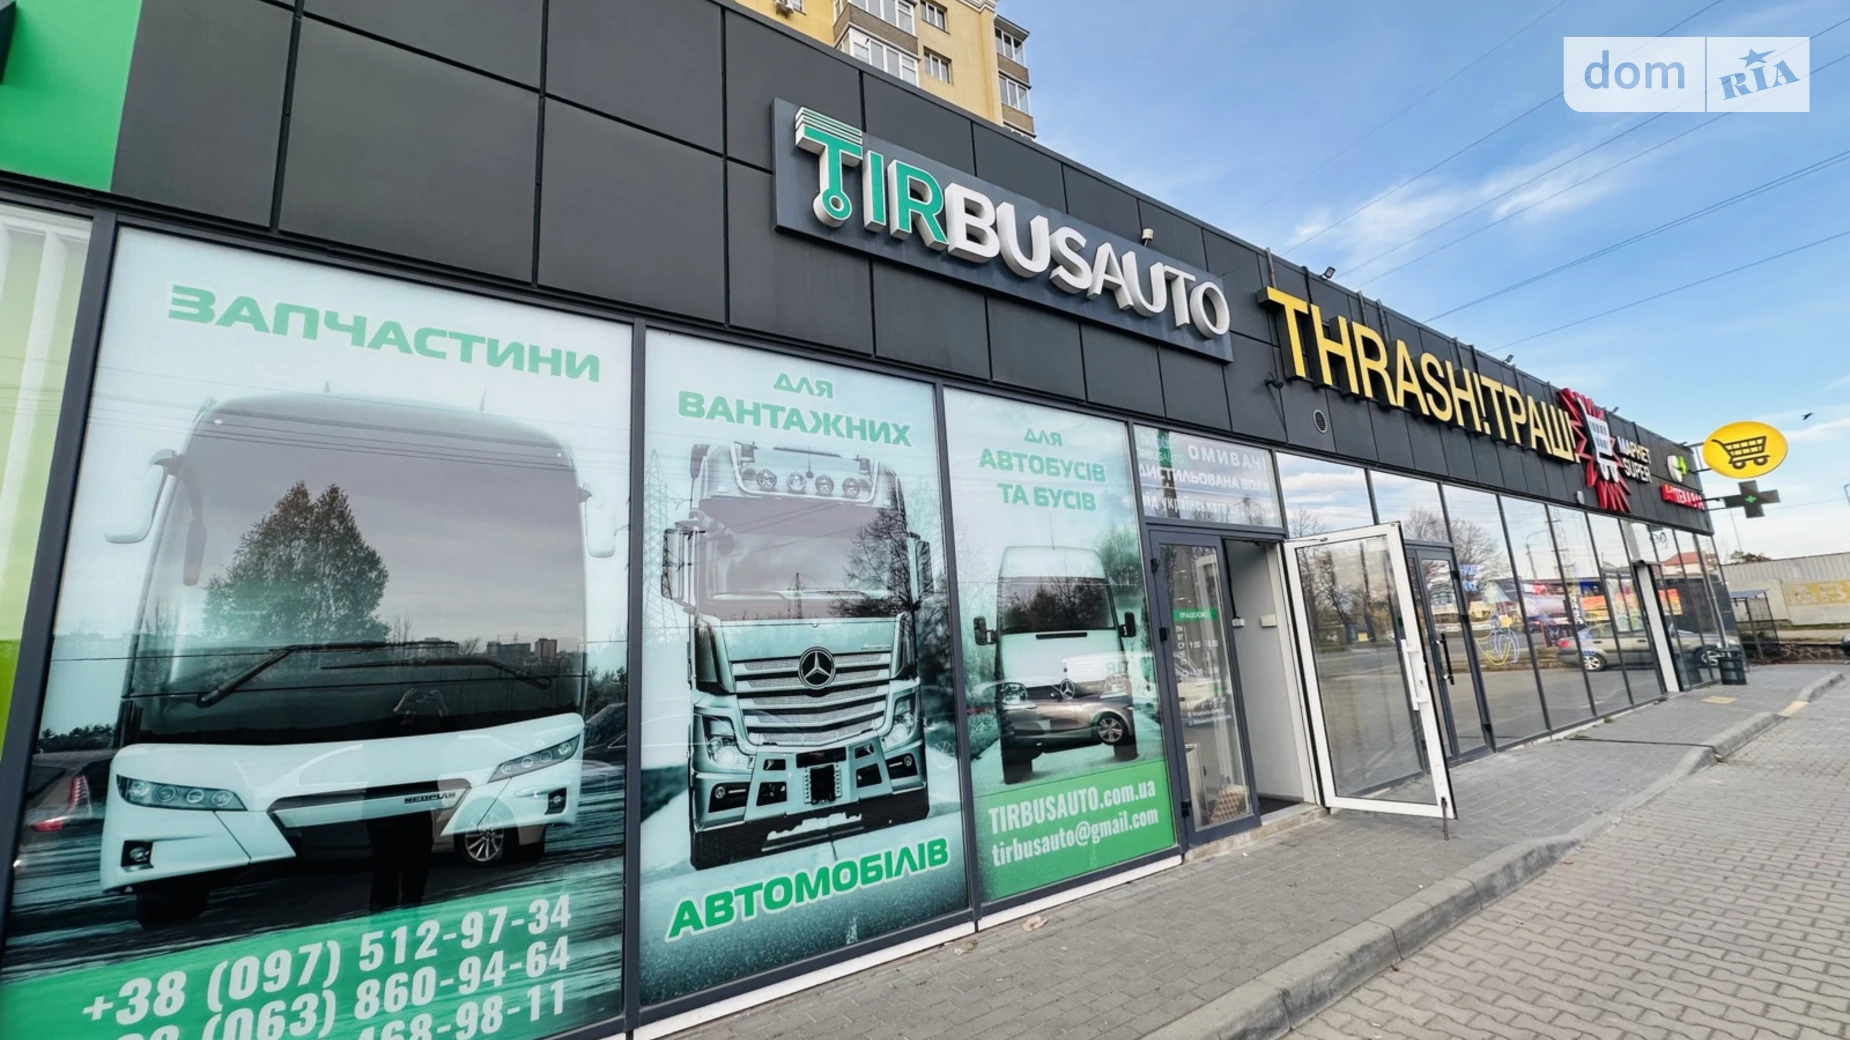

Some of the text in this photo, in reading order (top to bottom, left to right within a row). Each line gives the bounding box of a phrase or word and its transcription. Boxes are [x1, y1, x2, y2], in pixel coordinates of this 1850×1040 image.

[795, 106, 1230, 339] TIRBUSAUTO
[168, 284, 600, 382] ЗАПЧАСТИНИ
[773, 373, 833, 399] ДЛЯ
[678, 390, 912, 448] ВАНТАЖНИХ
[1024, 427, 1063, 447] ДЛЯ
[979, 448, 1106, 483] АВТОБУСІВ
[1187, 444, 1267, 471] ОМИВАЧІ
[997, 483, 1097, 512] ТА БУСІВ
[988, 780, 1156, 836] TIRBUSAUTO.com.ua
[992, 808, 1159, 867] tirbusauto@gmail.com
[667, 837, 950, 939] АВТОМОБІЛІВ
[82, 894, 571, 1026] +38 (097) 512-97-34
[202, 935, 570, 1040] (063) 860-94-64
